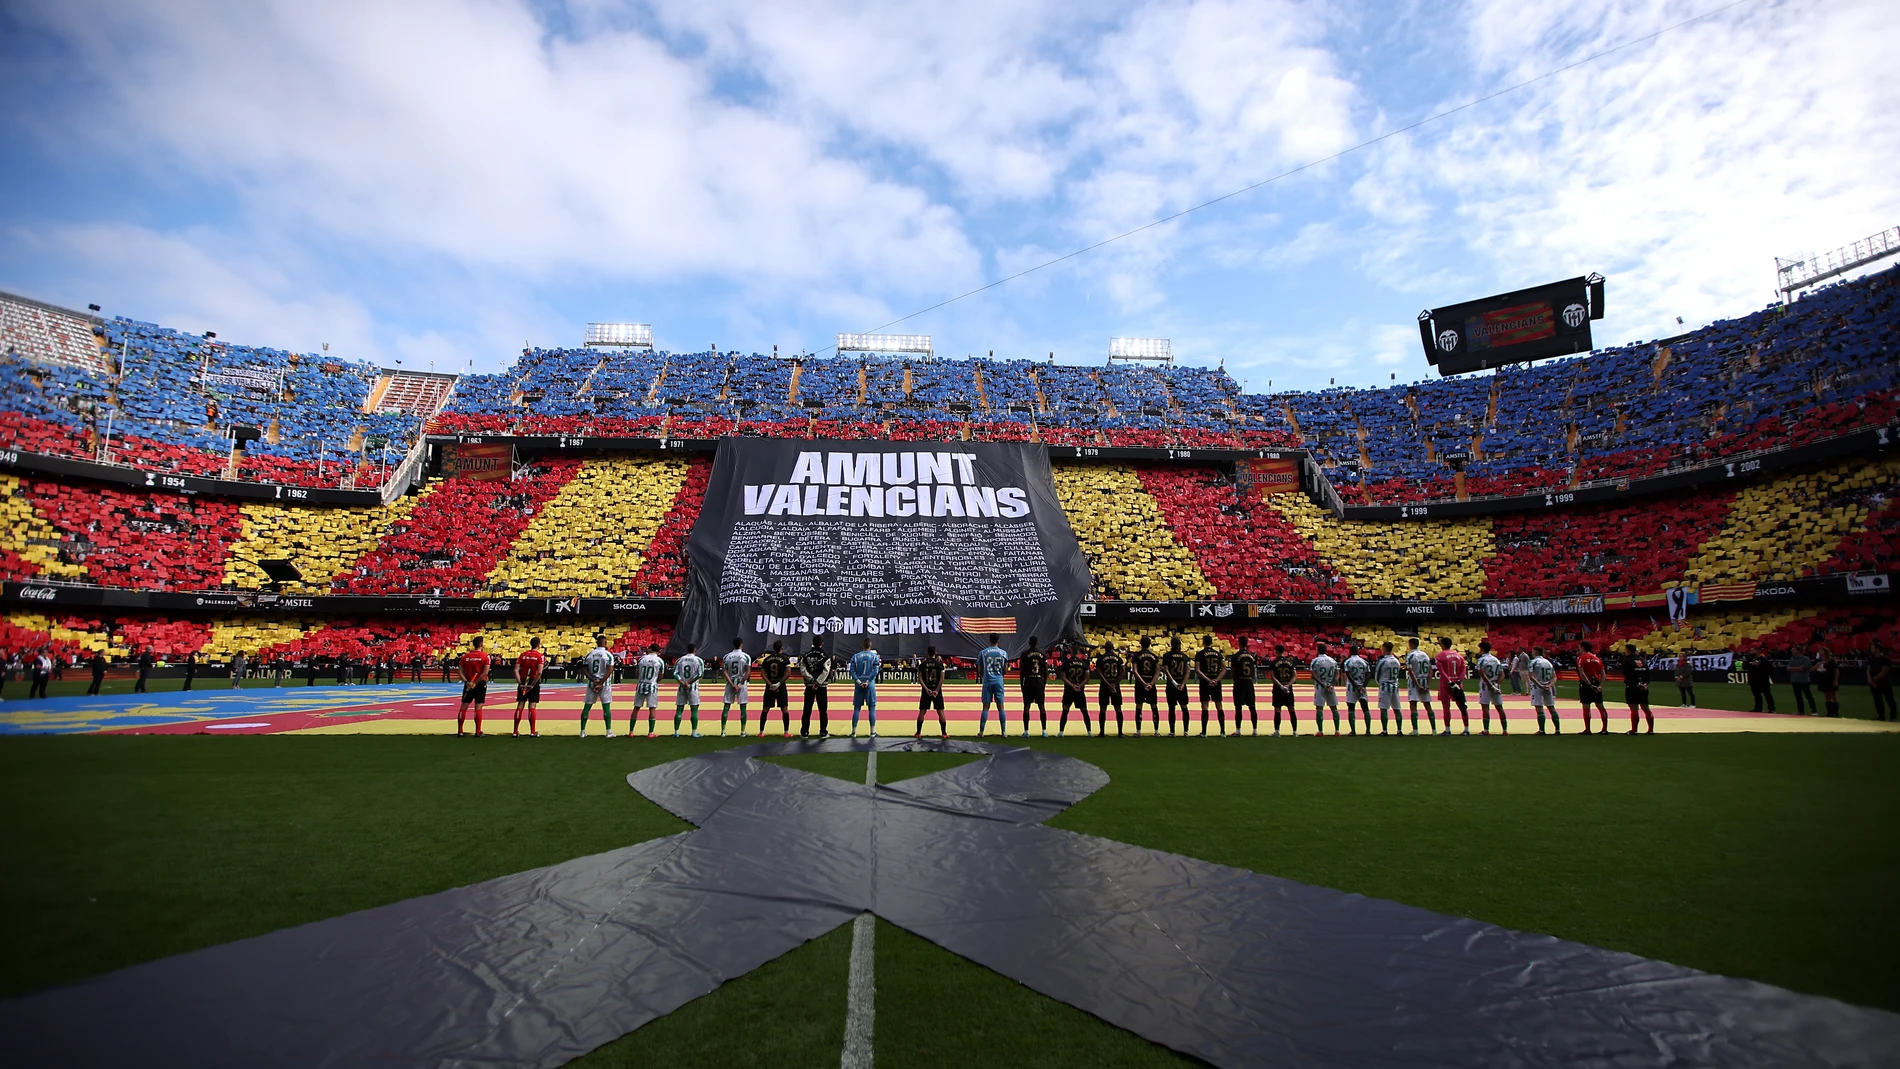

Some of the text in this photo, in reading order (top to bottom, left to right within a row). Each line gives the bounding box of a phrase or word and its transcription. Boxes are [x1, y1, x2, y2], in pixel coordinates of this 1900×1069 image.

[1474, 316, 1544, 337] VALENCIANS
[455, 457, 499, 471] AMUNT
[790, 451, 976, 486] AMUNT
[1740, 460, 1760, 472] 2002
[162, 476, 185, 488] 1954
[1242, 473, 1292, 483] VALENCIANS
[287, 489, 307, 499] 1962
[1555, 494, 1574, 503] 1999
[744, 484, 1030, 518] VALENCIANS
[1410, 507, 1427, 515] 1999
[910, 580, 973, 589] RAFELGUARAF
[719, 596, 760, 606] TORRENT
[774, 598, 796, 607] TOUS
[810, 597, 837, 605] TURÍS
[890, 597, 953, 607] VILAMARXANT
[1025, 596, 1058, 606] YÁTOVA
[720, 589, 763, 598] SINARCAS
[932, 591, 976, 601] TAVERNES
[1007, 591, 1057, 600] VALLDIGNA
[1487, 603, 1499, 617] LA
[1501, 602, 1535, 616] CURVA
[756, 614, 809, 636] UNITS
[867, 615, 943, 635] SEMPRE
[592, 660, 599, 673] 6
[641, 666, 654, 680] 10
[684, 665, 691, 679] 8
[732, 662, 739, 675] 5
[770, 663, 778, 677] 9
[1032, 659, 1039, 674] 3
[1104, 663, 1118, 677] 20
[1320, 667, 1334, 679] 24
[1418, 661, 1428, 674] 16
[1452, 661, 1457, 674] 1
[1541, 668, 1551, 680] 15
